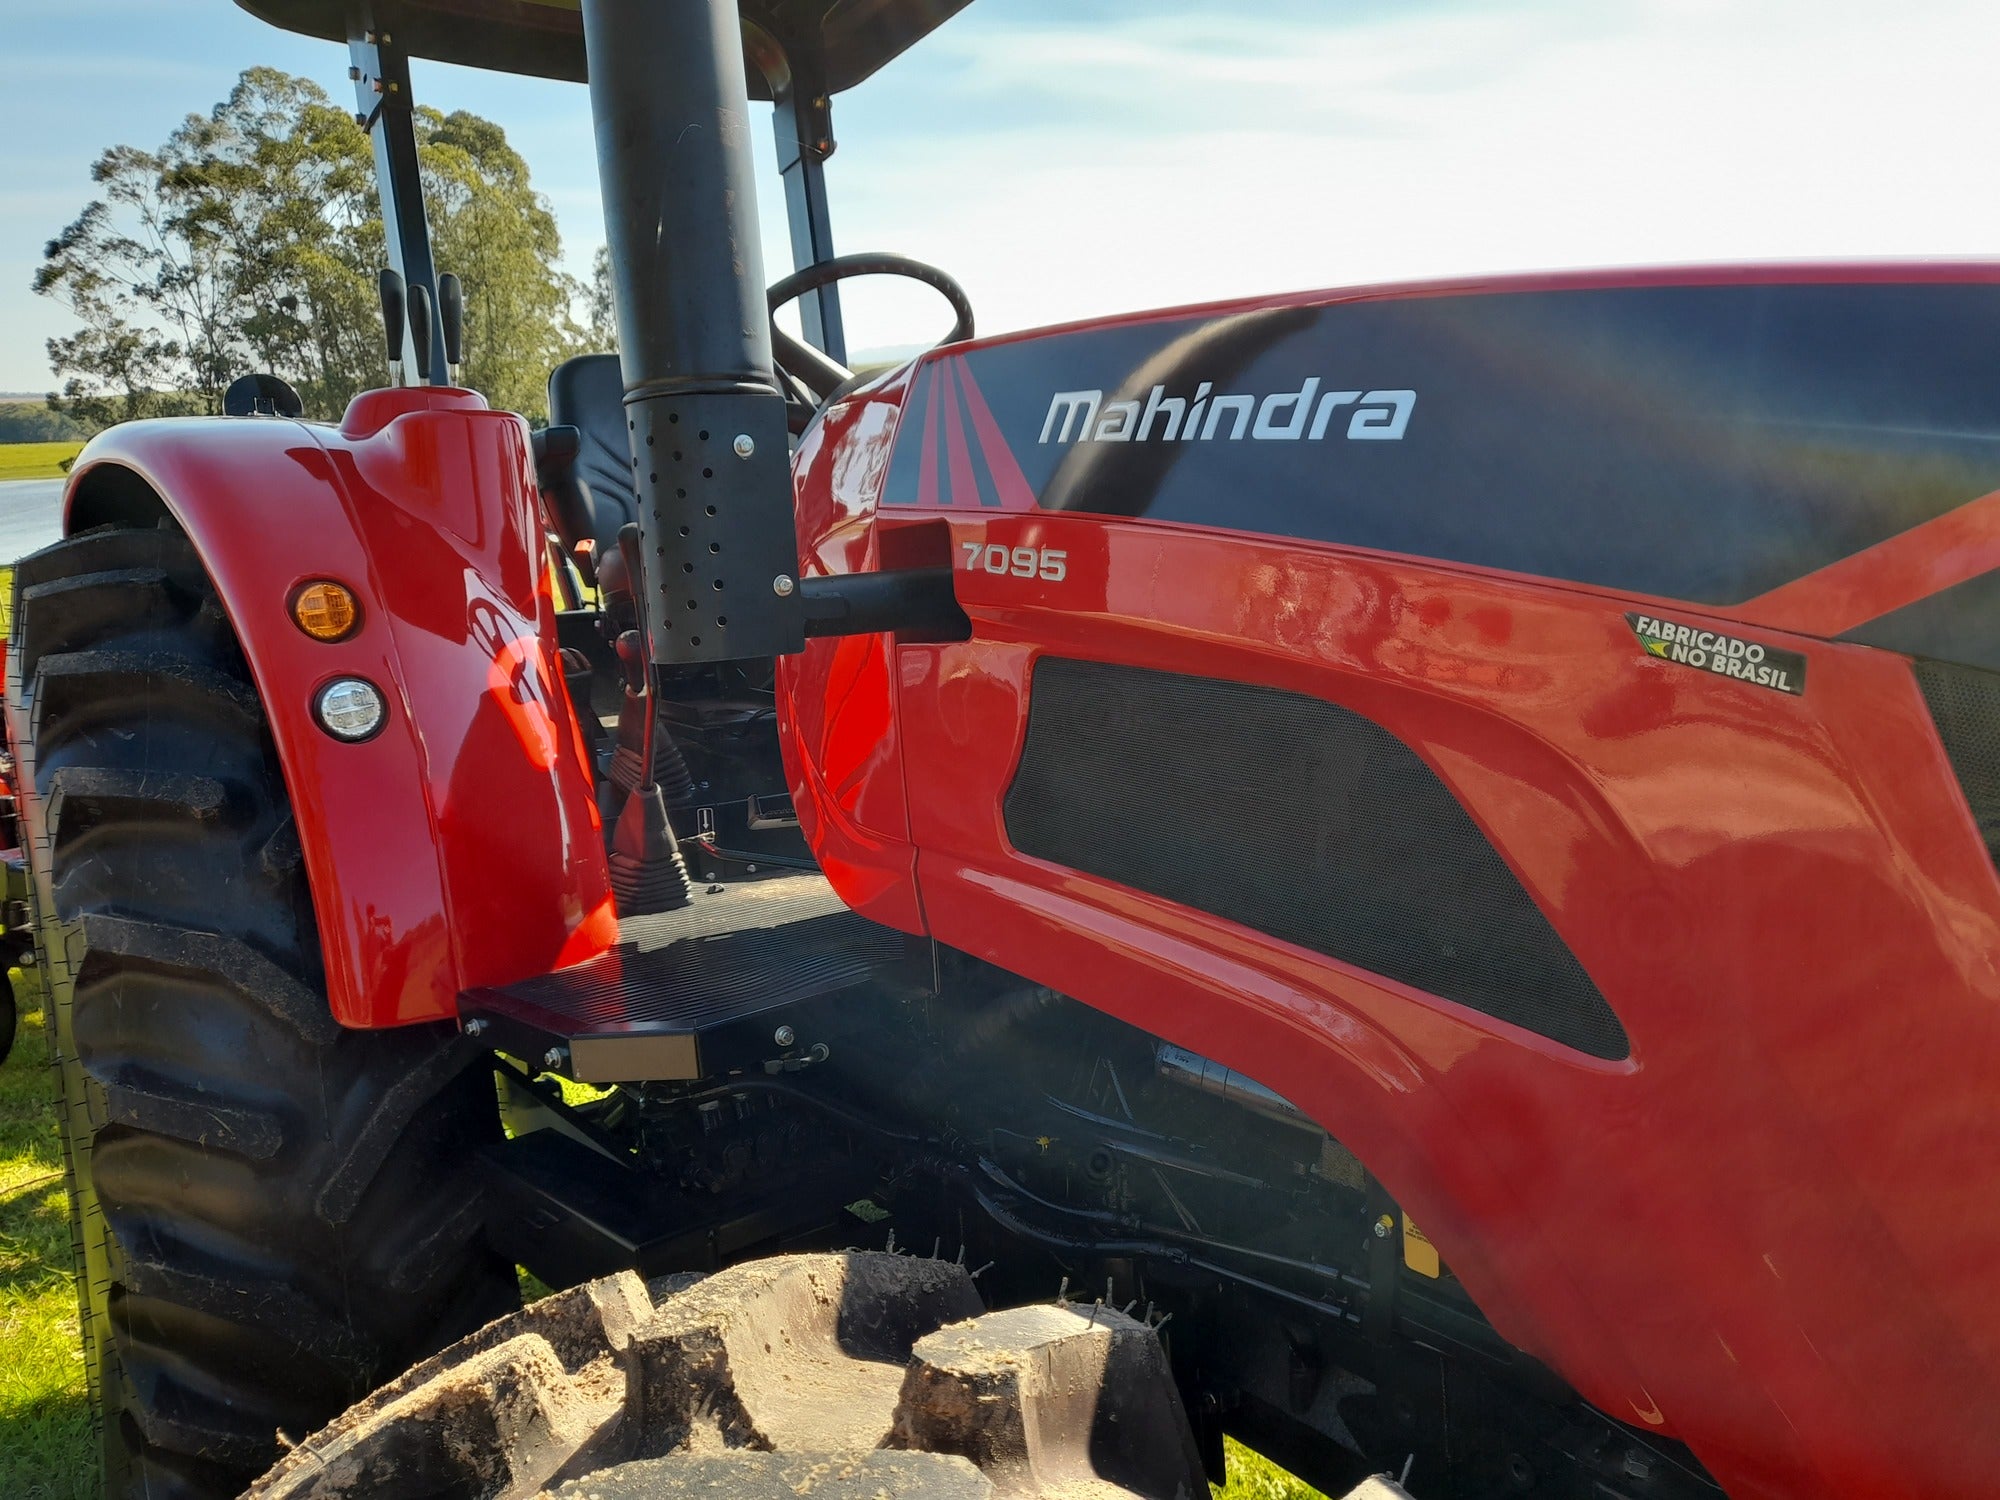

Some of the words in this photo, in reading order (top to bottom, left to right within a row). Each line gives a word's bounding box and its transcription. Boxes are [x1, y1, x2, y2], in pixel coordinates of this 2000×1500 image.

[1038, 376, 1417, 444] Mahindra
[962, 541, 1067, 581] 7095
[1636, 616, 1765, 663] FABRICADO
[1671, 644, 1706, 667] NO
[1711, 655, 1791, 691] BRASIL
